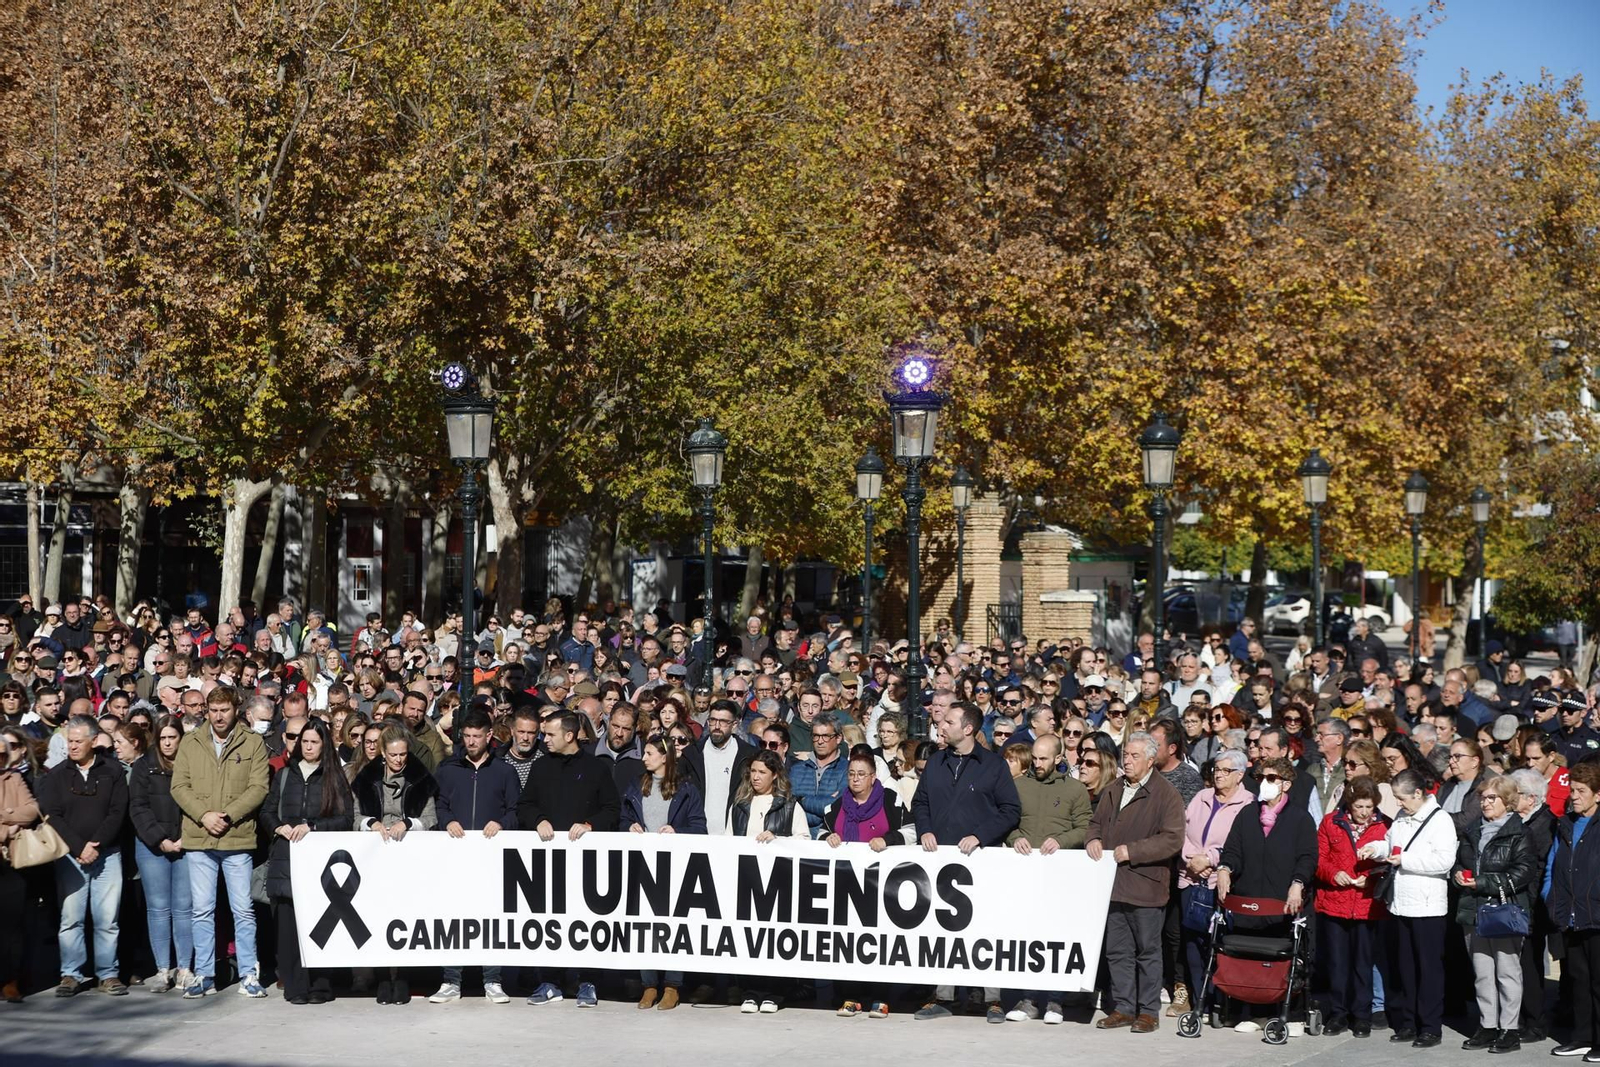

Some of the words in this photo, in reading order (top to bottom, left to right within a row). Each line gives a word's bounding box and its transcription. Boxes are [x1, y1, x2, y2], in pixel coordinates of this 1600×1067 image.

[502, 848, 567, 915] NI
[582, 849, 722, 920] UNA
[736, 854, 974, 932] MENOS
[386, 918, 562, 952] CAMPILLOS
[568, 919, 694, 955] CONTRA
[700, 924, 738, 958] LA
[743, 926, 912, 968] VIOLENCIA
[918, 935, 1086, 975] MACHISTA
